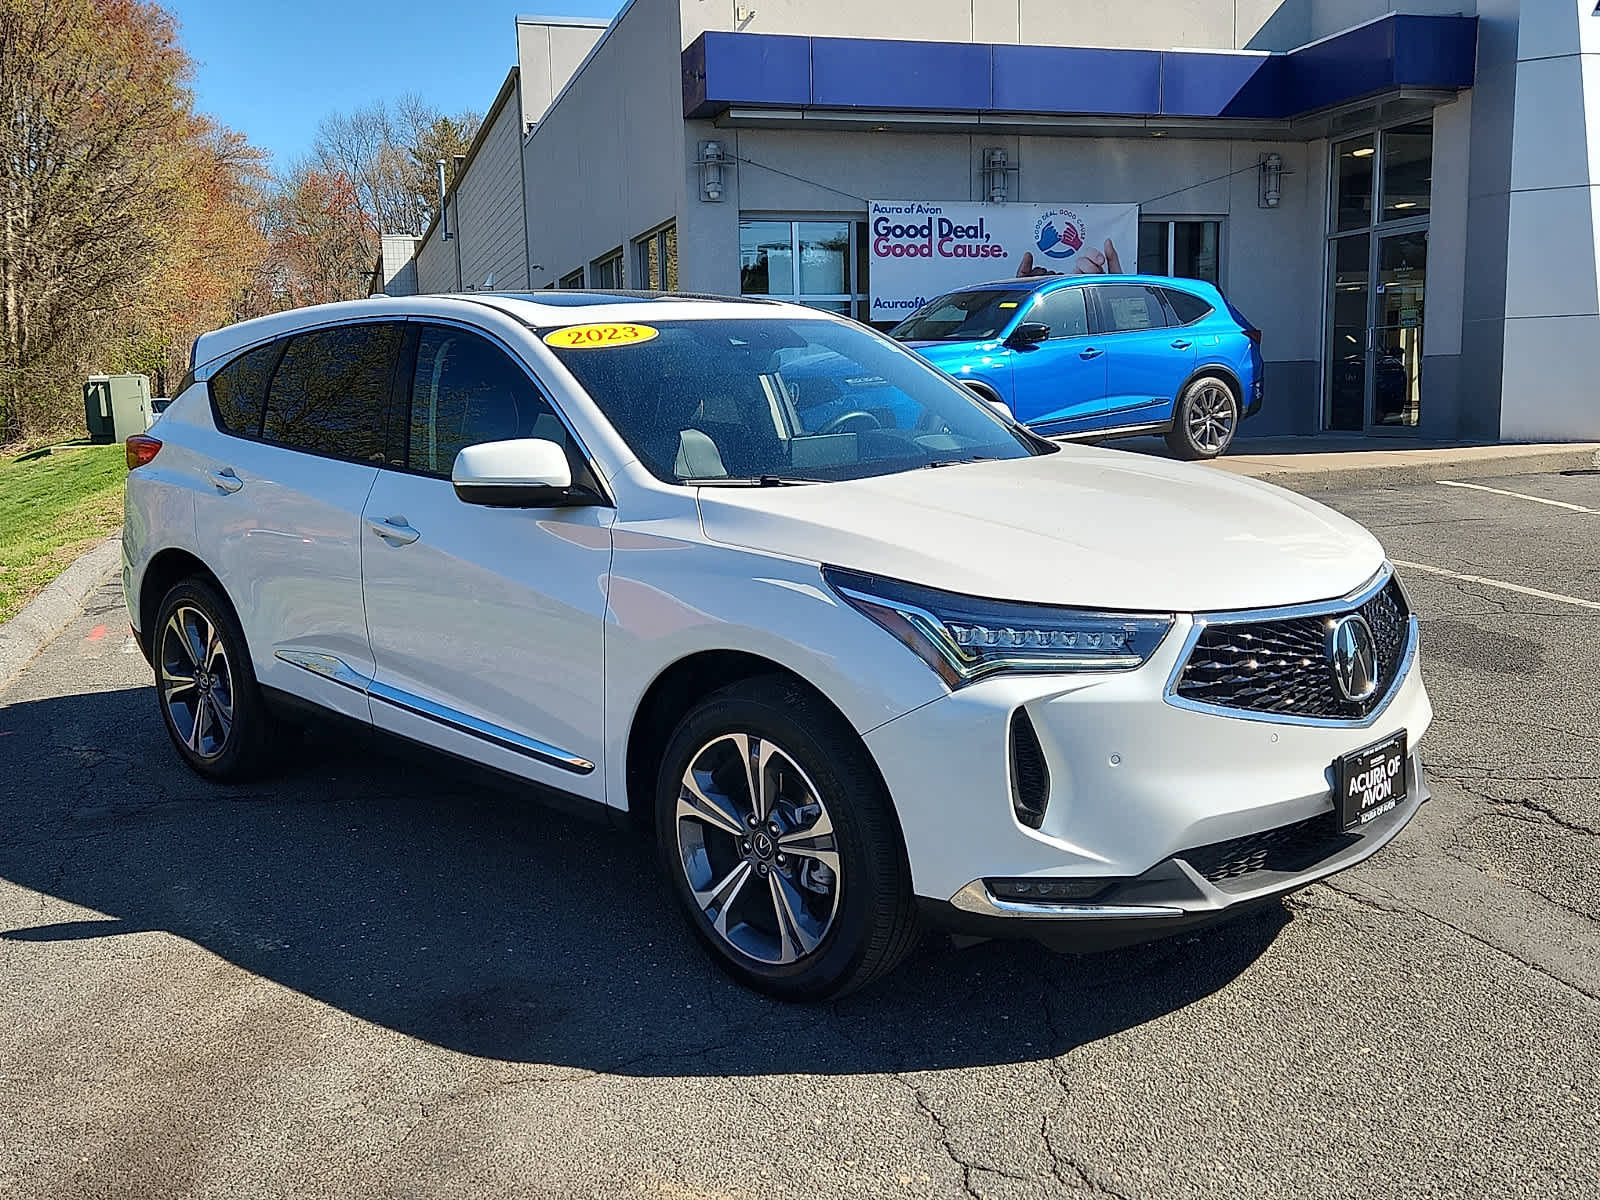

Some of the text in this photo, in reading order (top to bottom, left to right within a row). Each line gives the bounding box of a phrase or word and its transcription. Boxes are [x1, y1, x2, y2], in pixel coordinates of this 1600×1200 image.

[872, 203, 942, 214] Acura of Avon
[873, 216, 991, 243] Good Deal,
[873, 236, 1009, 258] Good Cause.
[567, 326, 639, 345] 2023
[1348, 764, 1387, 797] ACURA
[1387, 755, 1401, 777] OF
[1361, 777, 1392, 809] AVON
